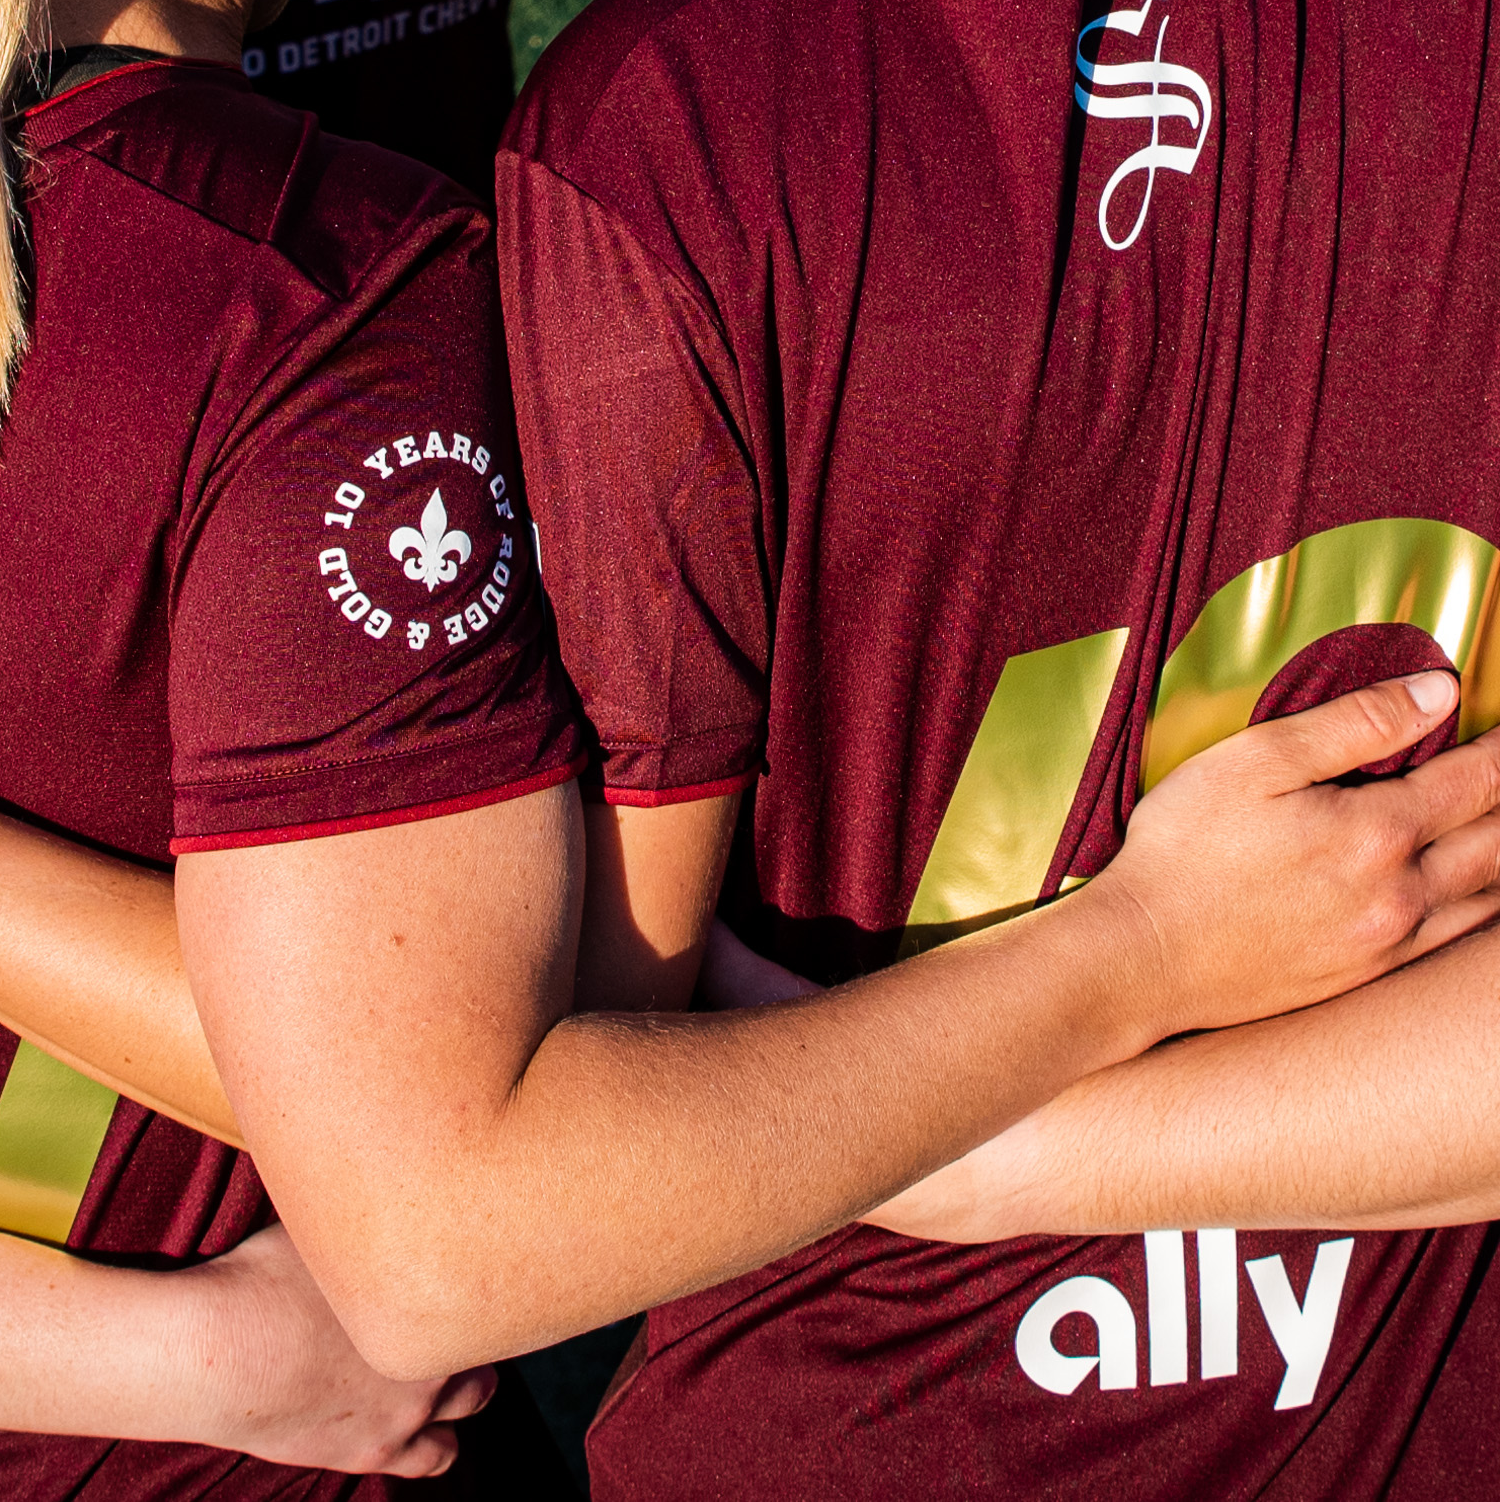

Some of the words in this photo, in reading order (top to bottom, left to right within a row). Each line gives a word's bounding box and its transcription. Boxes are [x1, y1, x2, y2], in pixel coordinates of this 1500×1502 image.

[278, 11, 412, 74] DETROIT
[363, 431, 491, 479] YEARS
[324, 482, 366, 530] 10
[489, 474, 514, 519] OF
[318, 547, 392, 640] GOLD
[443, 534, 513, 646] ROUGE
[407, 620, 430, 650] &
[1014, 1226, 1355, 1412] ally
